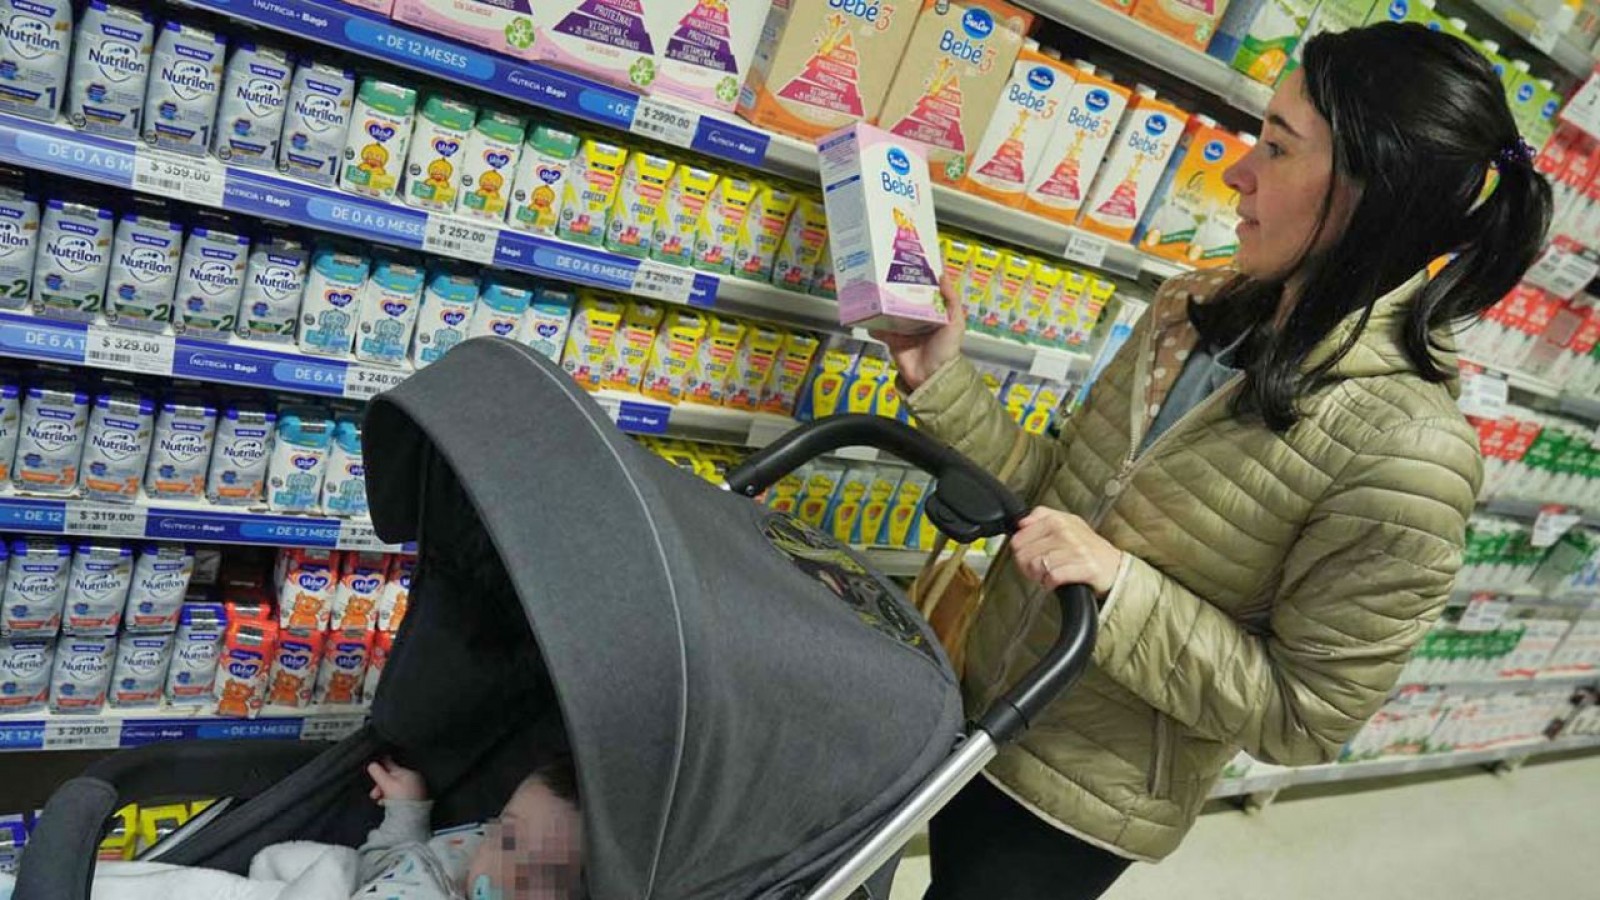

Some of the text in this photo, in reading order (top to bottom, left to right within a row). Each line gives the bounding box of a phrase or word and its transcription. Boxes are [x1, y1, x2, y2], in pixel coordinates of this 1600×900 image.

[875, 4, 894, 31] 3
[0, 22, 60, 50] Nutrilon
[386, 34, 405, 50] DE
[407, 41, 422, 55] 12
[423, 46, 467, 68] MESES
[939, 29, 996, 72] Bebé 3
[88, 48, 145, 73] Nutrilon
[162, 67, 215, 92] Nutrilon
[45, 87, 57, 109] 1
[1008, 84, 1058, 119] Bebé 3
[130, 108, 140, 129] 1
[294, 101, 343, 124] Nutrilon
[615, 103, 631, 117] DE
[652, 109, 690, 129] 2990.00
[1067, 106, 1112, 139] Bebé 3
[200, 125, 209, 146] 1
[1128, 131, 1158, 155] Bebé
[50, 143, 70, 159] DE
[74, 147, 85, 162] 0
[89, 151, 101, 166] A
[104, 154, 116, 169] 6
[328, 156, 337, 175] 1
[881, 171, 915, 199] Bebé
[332, 206, 426, 237] DE 0 A 6 MESES
[439, 224, 486, 243] $ 252.00
[46, 243, 101, 263] Nutrilon
[120, 254, 172, 274] Nutrilon
[556, 255, 571, 268] DE
[573, 259, 580, 268] 0
[582, 261, 590, 271] A
[592, 263, 600, 273] 6
[189, 268, 238, 286] Nutrilon
[255, 274, 300, 290] Nutrilon
[10, 279, 29, 299] 2
[83, 294, 100, 313] 2
[153, 304, 169, 322] 2
[220, 314, 234, 331] 2
[25, 331, 45, 346] DE
[50, 334, 60, 347] 6
[64, 337, 75, 348] A
[102, 337, 160, 354] $ 329.00
[294, 367, 310, 380] DE
[315, 369, 322, 381] 6
[324, 372, 333, 382] A
[359, 370, 365, 382] $
[26, 426, 77, 442] Nutrilon
[93, 435, 141, 452] Nutrilon
[160, 439, 207, 454] Nutrilon
[25, 510, 44, 521] DE
[49, 511, 63, 522] 12
[80, 510, 136, 522] $ 319.00
[276, 526, 291, 537] DE
[294, 527, 306, 538] 12
[75, 579, 121, 590] Nutrilon
[141, 579, 185, 589] Nutrilon
[61, 660, 107, 671] Nutrilon
[69, 726, 109, 736] 299.00
[230, 724, 249, 735] DE
[262, 723, 298, 734] MESES
